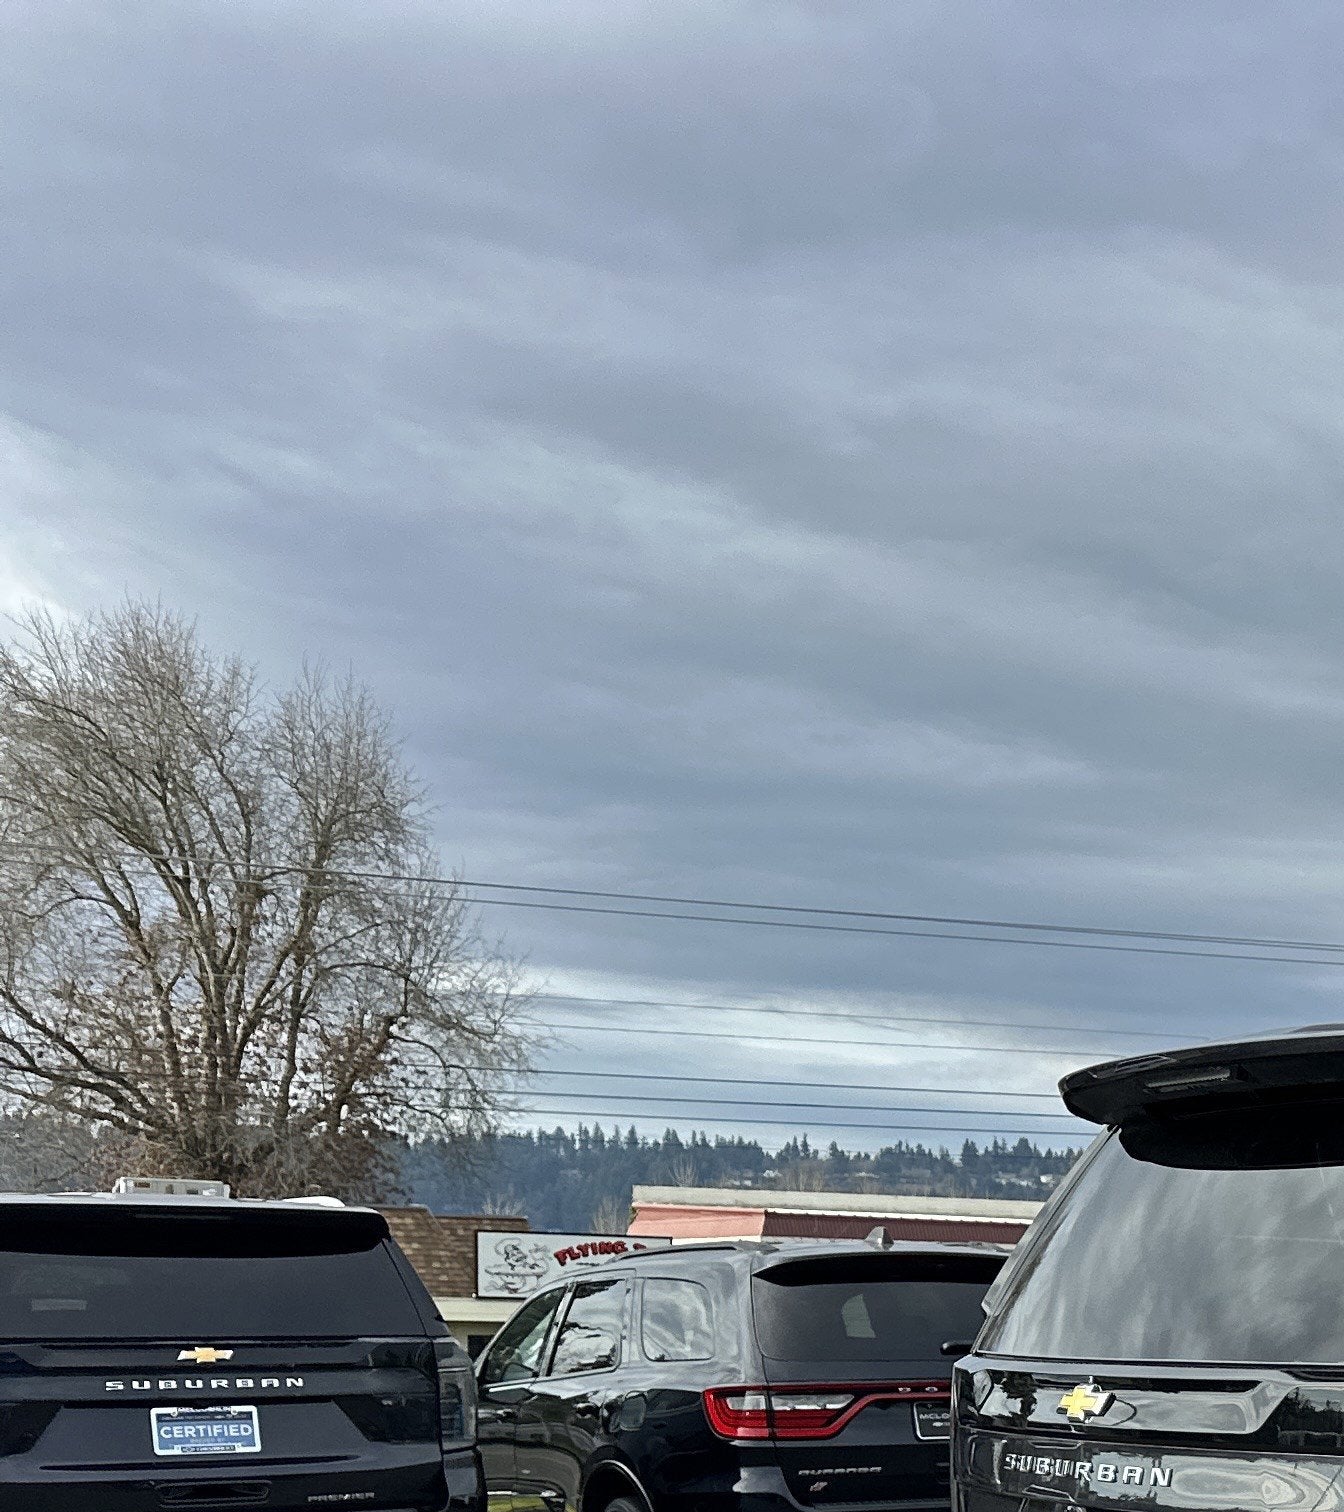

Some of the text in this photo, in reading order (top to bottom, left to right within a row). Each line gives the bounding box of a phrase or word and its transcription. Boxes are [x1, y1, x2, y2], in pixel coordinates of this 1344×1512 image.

[553, 1240, 629, 1267] FLYING
[105, 1377, 304, 1391] SUBURBAN
[160, 1423, 253, 1439] CERTIFIED
[1003, 1453, 1174, 1488] SUBURBAN
[307, 1491, 375, 1502] PREMIER
